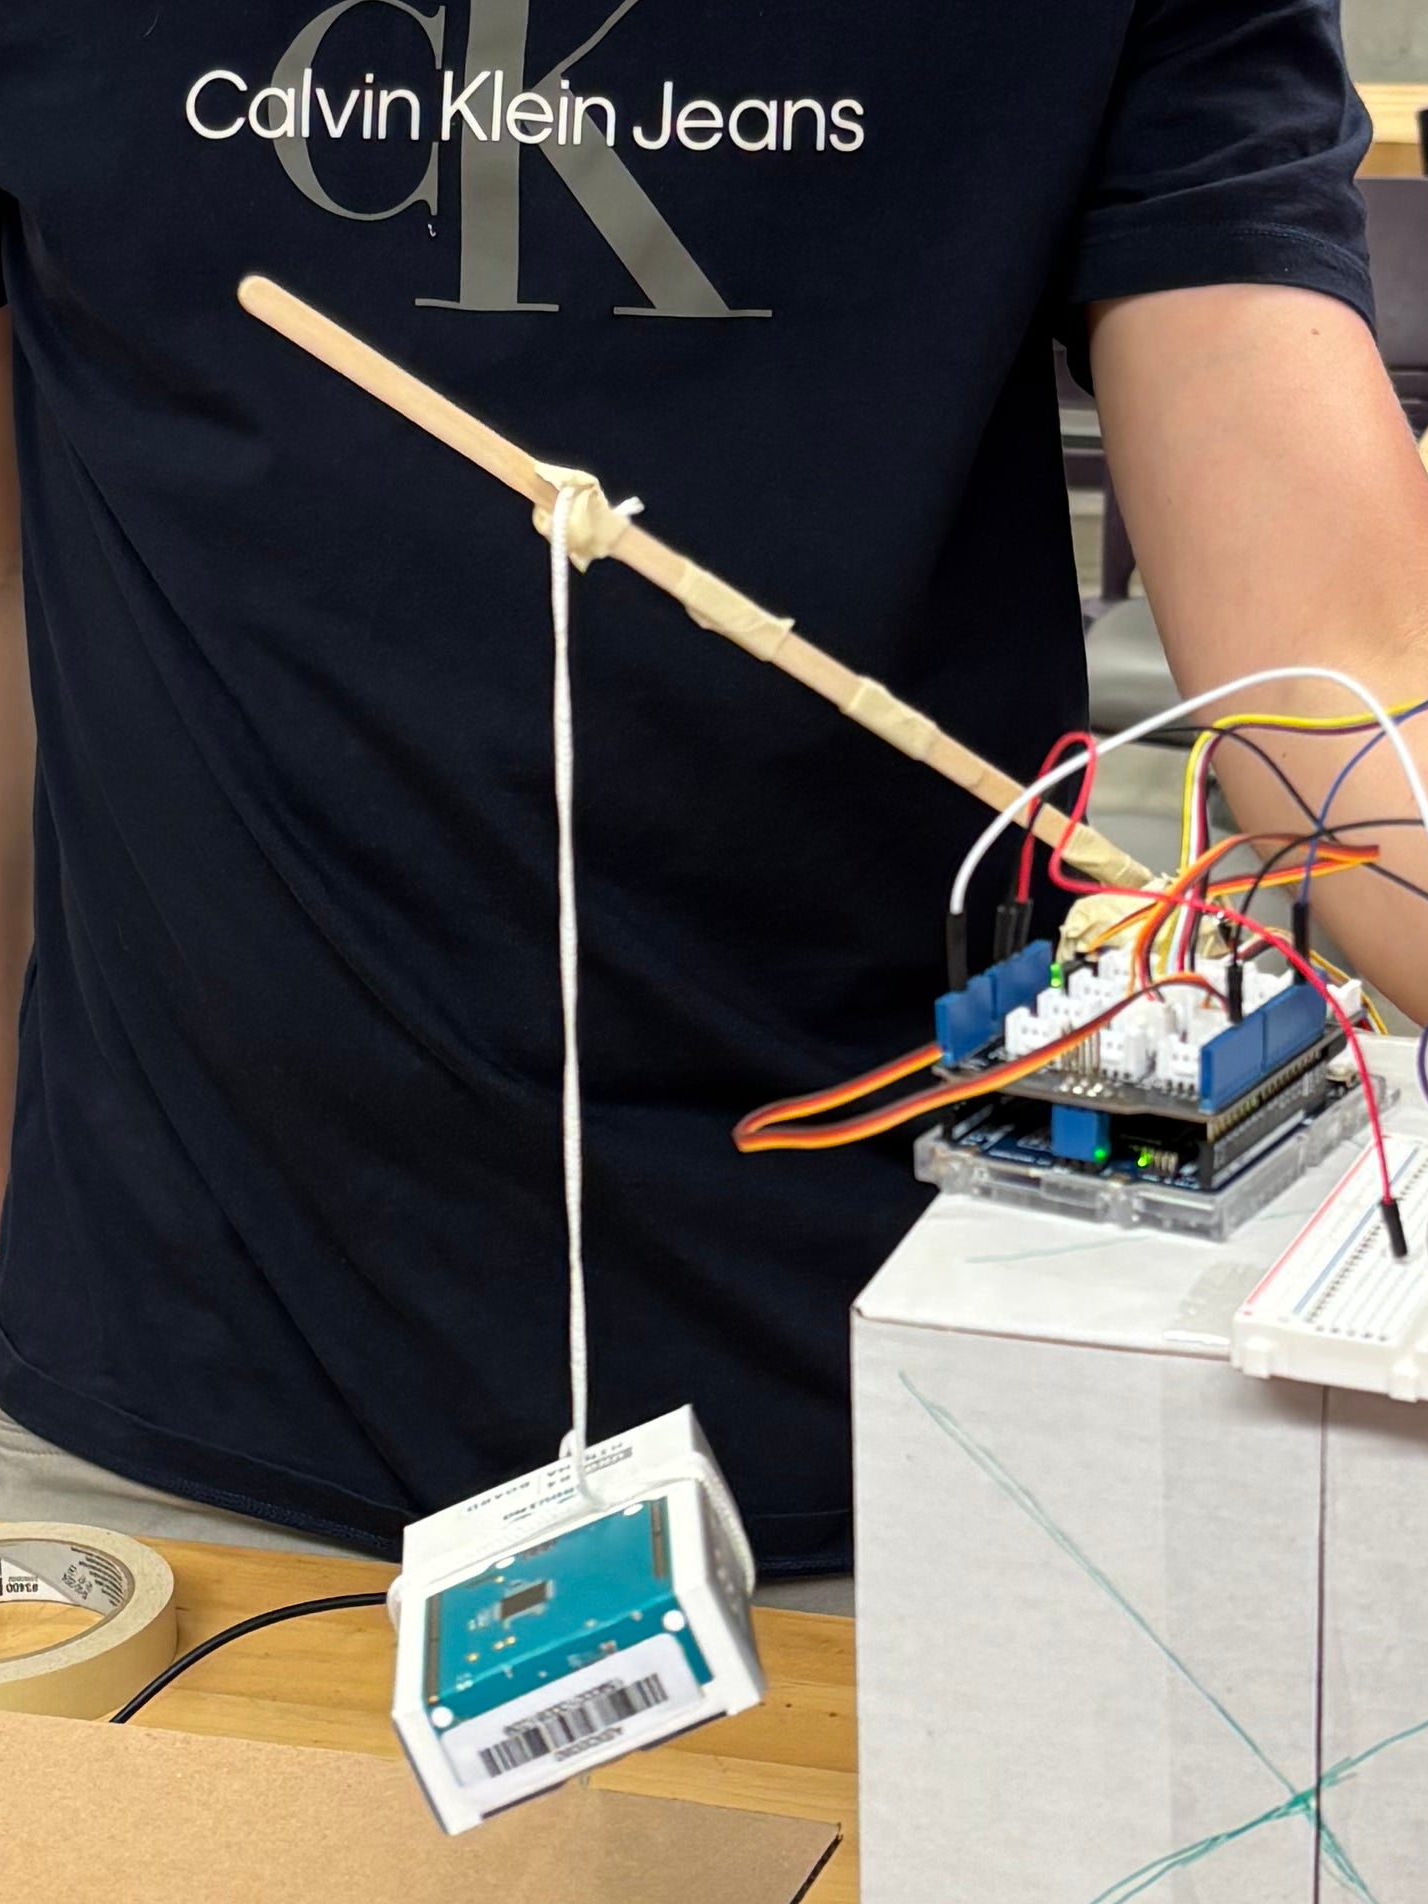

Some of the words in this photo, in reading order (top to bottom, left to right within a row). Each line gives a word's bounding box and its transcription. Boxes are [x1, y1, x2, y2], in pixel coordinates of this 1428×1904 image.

[185, 68, 420, 140] Calvin
[441, 70, 616, 146] Klein
[632, 81, 865, 152] Jeans
